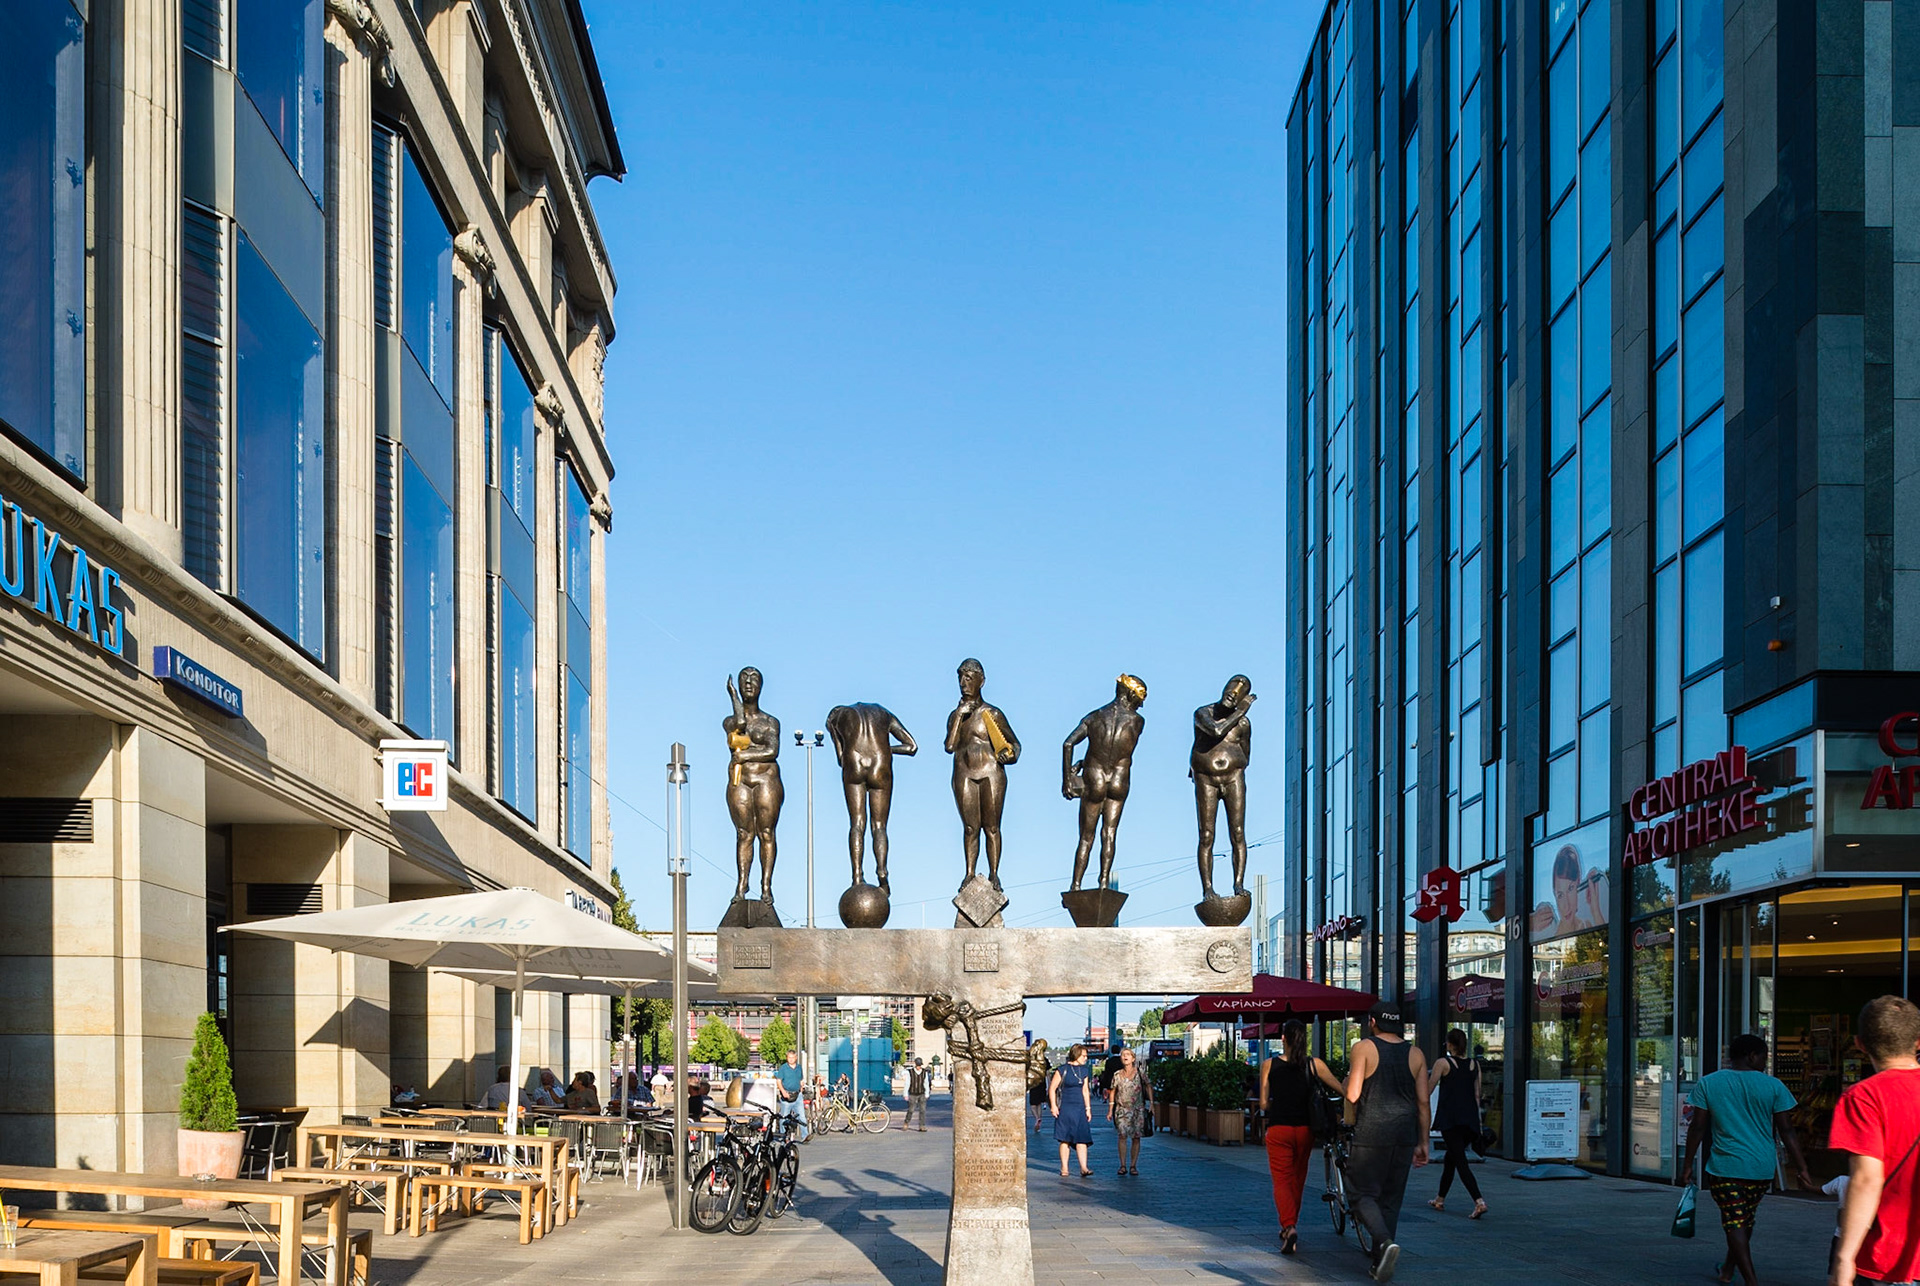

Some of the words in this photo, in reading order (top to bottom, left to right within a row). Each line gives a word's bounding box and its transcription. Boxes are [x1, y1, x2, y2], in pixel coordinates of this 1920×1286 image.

[176, 655, 240, 709] KONDITOR
[1629, 746, 1755, 822] CENTRAL
[1623, 786, 1766, 868] APOTHEKE
[407, 912, 535, 931] LUKAS
[1313, 915, 1347, 942] VAPIANO
[1507, 915, 1521, 941] 16
